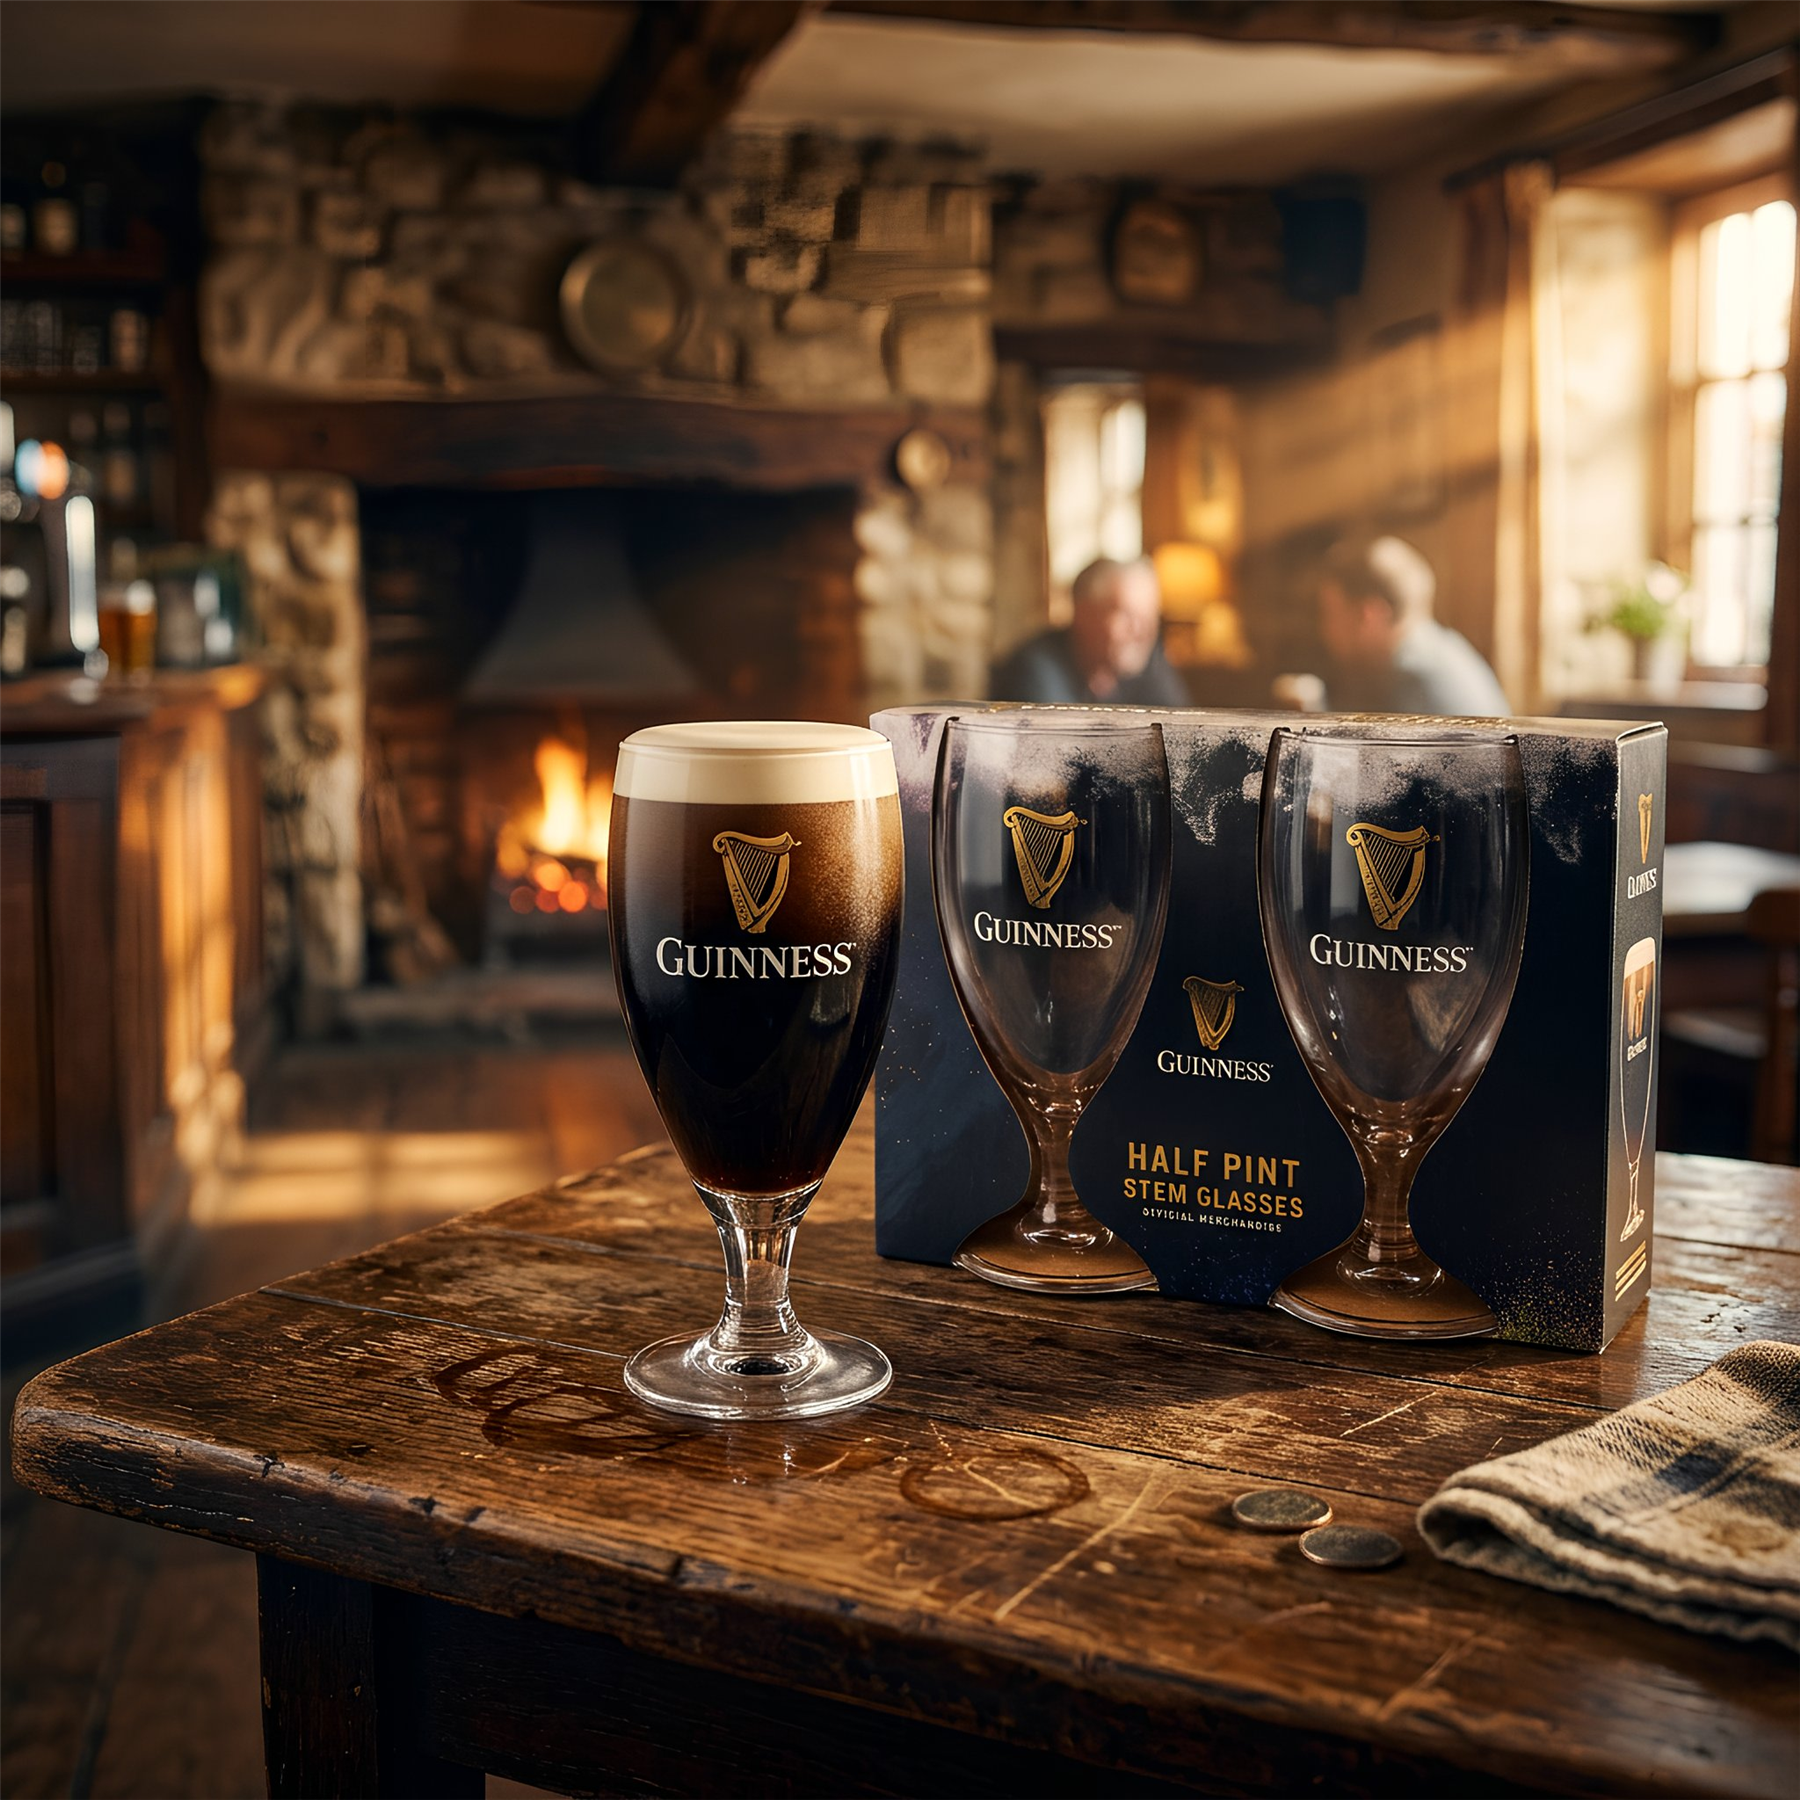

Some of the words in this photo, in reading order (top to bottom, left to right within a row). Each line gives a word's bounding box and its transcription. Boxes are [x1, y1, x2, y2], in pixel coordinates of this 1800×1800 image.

[973, 912, 1122, 950] GUINNESS
[655, 937, 856, 979] GUINNESS
[1310, 933, 1472, 972] GUINNESS
[1157, 1049, 1274, 1083] GUINNESS
[1128, 1142, 1209, 1177] HALF
[1224, 1153, 1300, 1187] PINT
[1124, 1178, 1187, 1204] STEM
[1197, 1187, 1303, 1218] GLASSES
